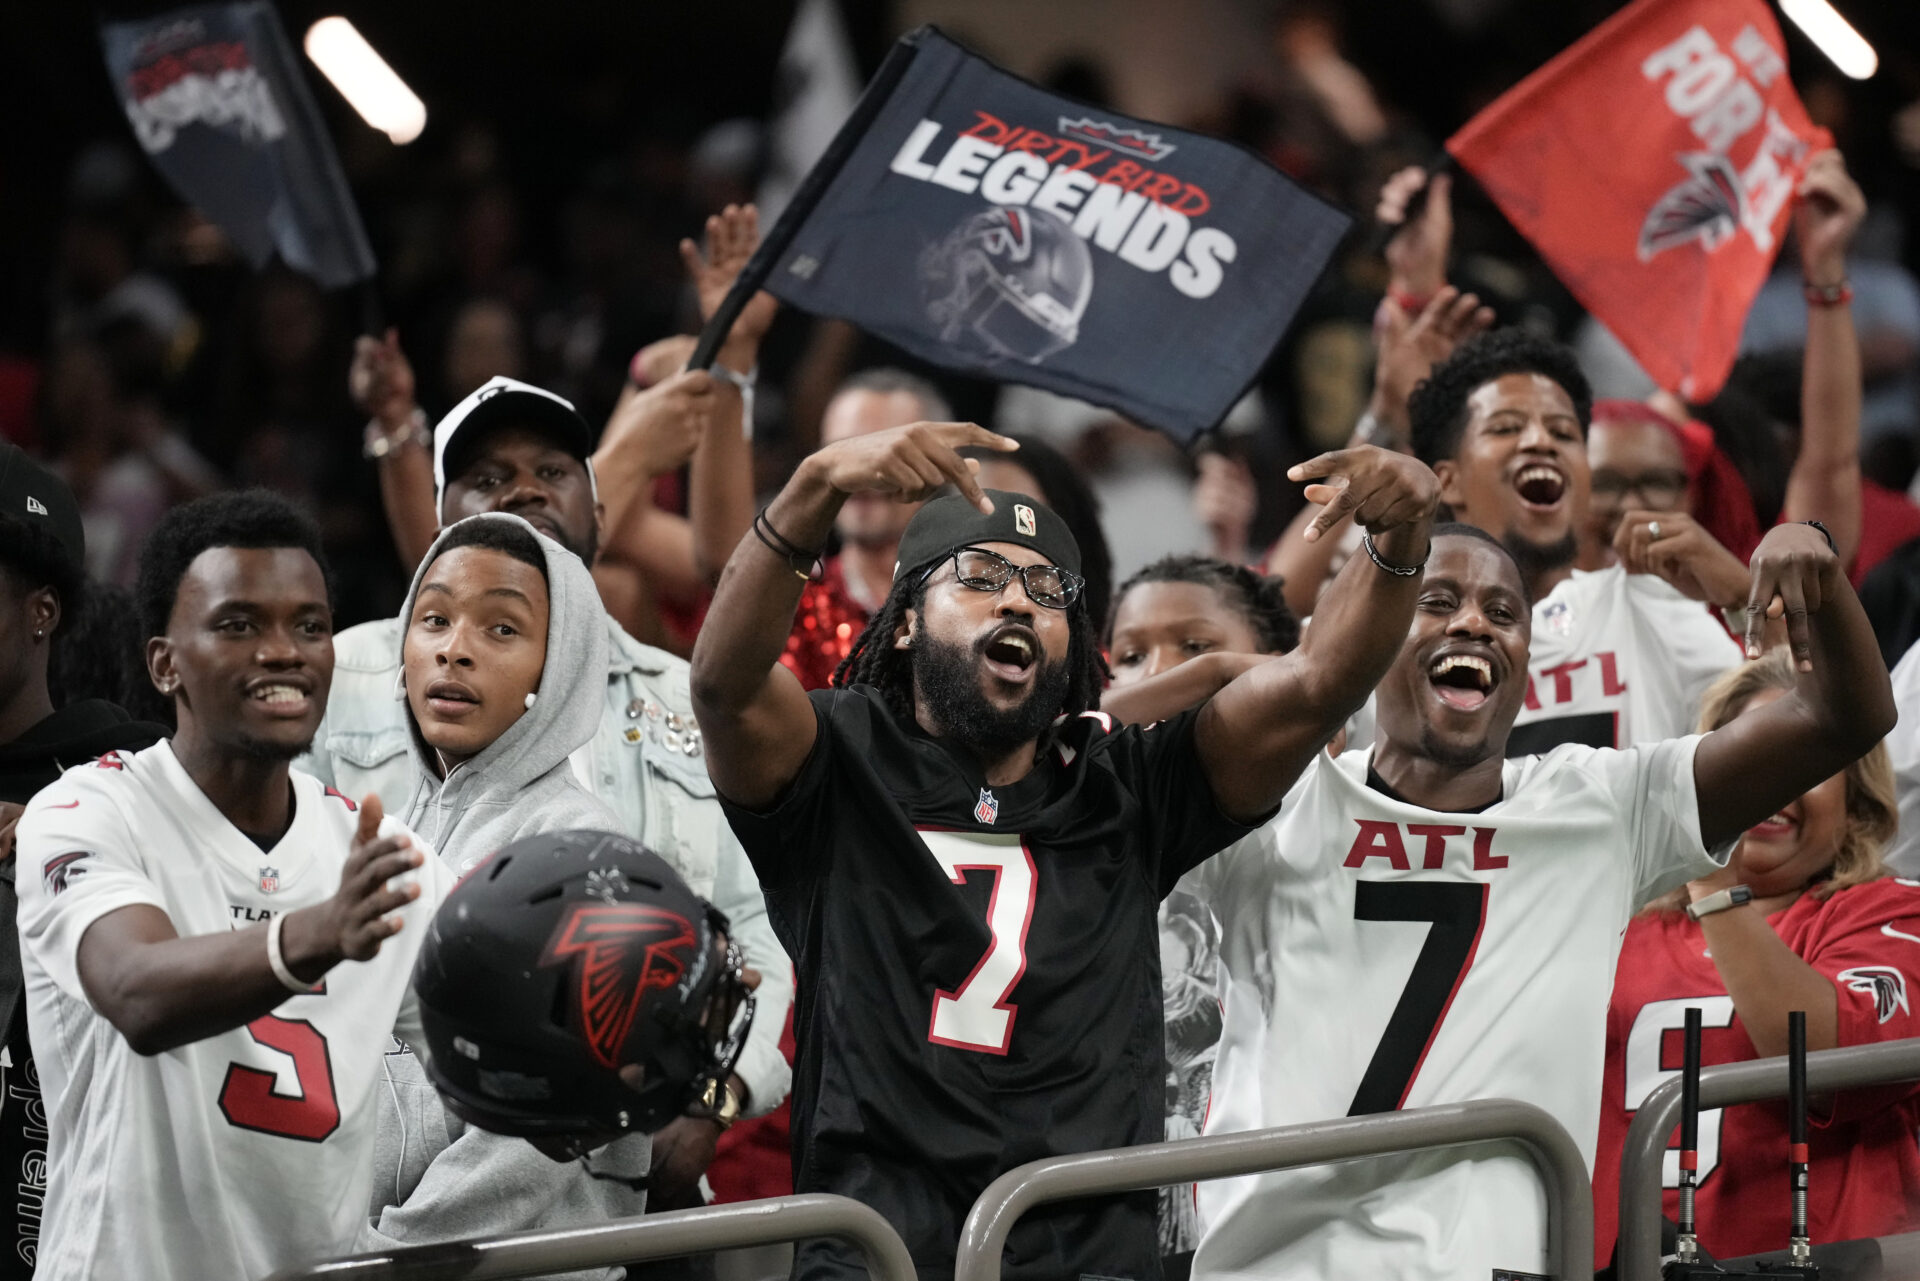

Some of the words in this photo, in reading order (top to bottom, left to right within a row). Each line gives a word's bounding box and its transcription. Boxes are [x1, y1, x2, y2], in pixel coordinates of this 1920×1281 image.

[1641, 24, 1765, 152] FOR
[889, 117, 1238, 299] LEGENDS
[957, 110, 1112, 176] DIRTY
[1090, 159, 1211, 218] BIRD
[979, 801, 997, 823] NFL
[1342, 818, 1509, 871] ATL
[912, 823, 1039, 1057] 7
[1346, 879, 1491, 1117] 7
